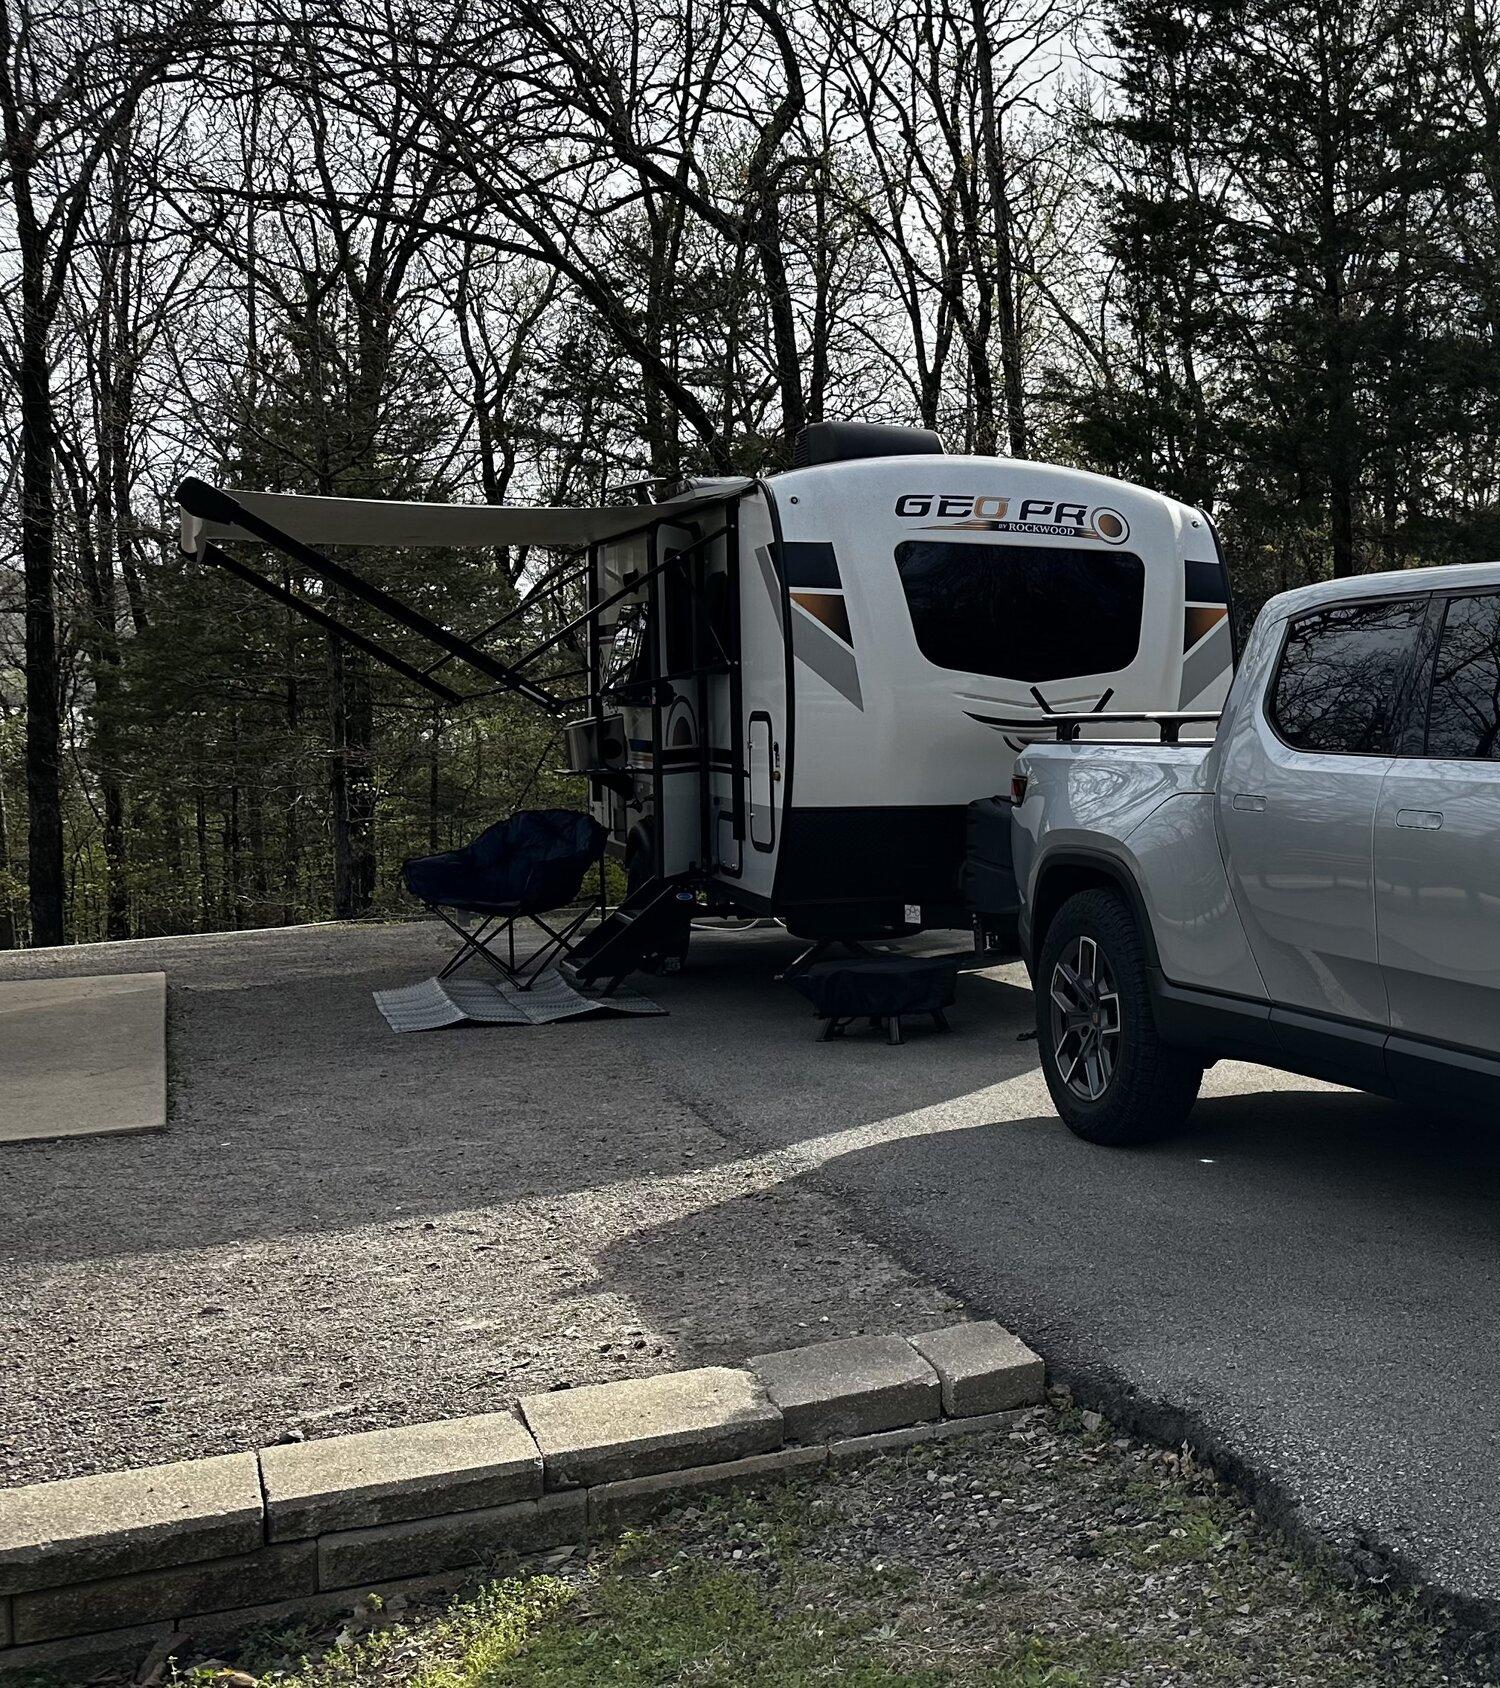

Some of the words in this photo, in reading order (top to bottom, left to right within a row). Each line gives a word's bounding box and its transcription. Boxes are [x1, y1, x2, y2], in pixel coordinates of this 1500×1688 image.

[894, 494, 1011, 519] GEO
[1018, 499, 1131, 545] PRO
[1008, 522, 1075, 536] ROCKWOOD
